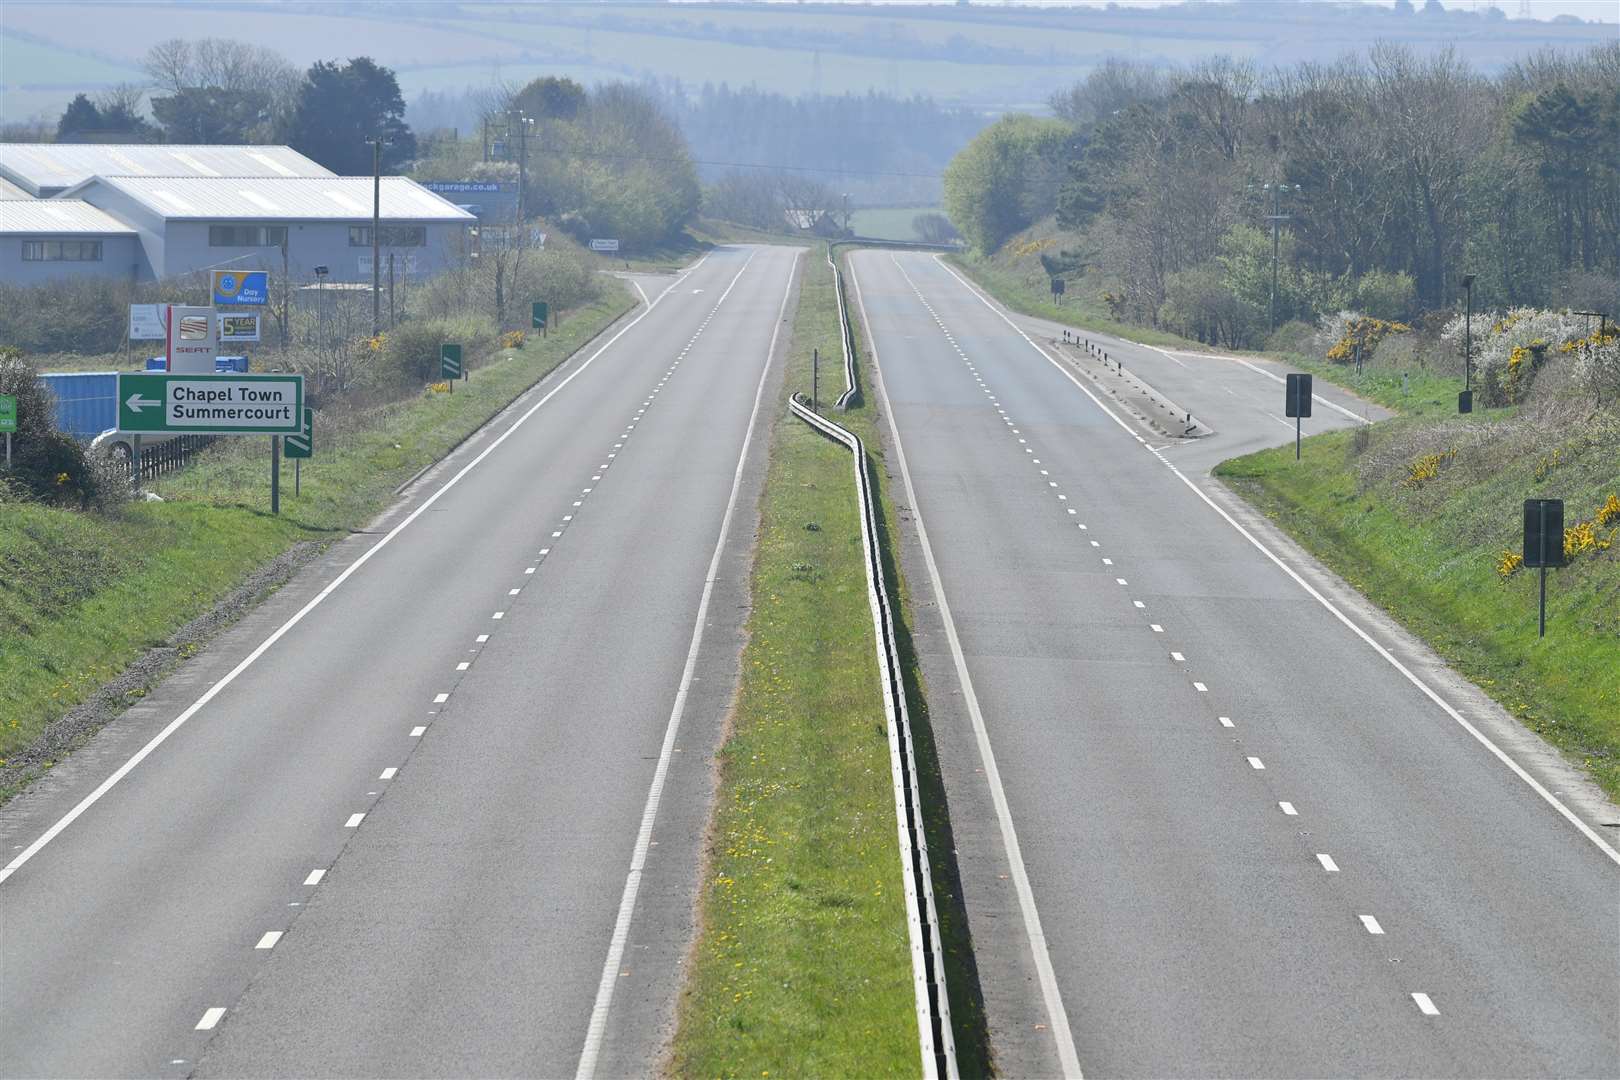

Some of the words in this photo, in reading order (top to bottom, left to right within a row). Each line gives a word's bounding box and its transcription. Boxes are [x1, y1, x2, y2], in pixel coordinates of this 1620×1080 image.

[237, 295, 265, 304] Nursery
[244, 288, 258, 297] Day
[224, 318, 234, 335] 5
[235, 318, 256, 327] YEAR
[173, 387, 232, 403] Chapel
[238, 387, 282, 402] Town
[173, 404, 290, 420] Summercourt
